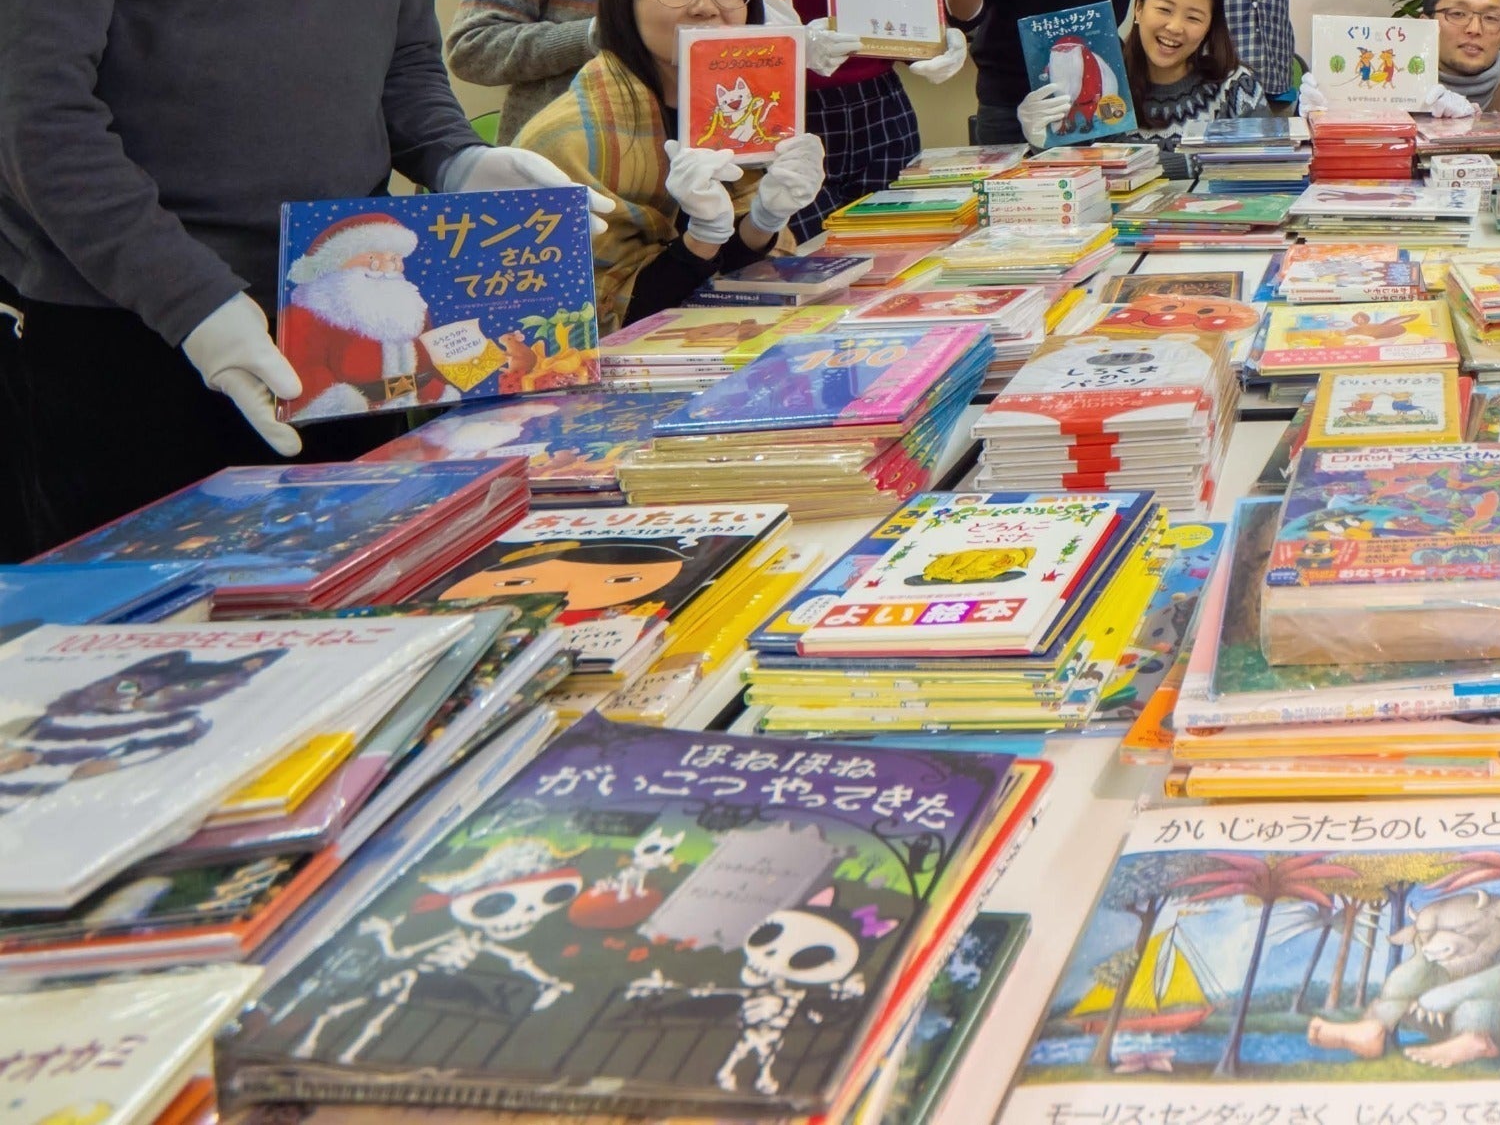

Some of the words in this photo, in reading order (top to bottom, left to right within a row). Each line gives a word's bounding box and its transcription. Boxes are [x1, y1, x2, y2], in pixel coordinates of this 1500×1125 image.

[428, 208, 563, 258] サンタ
[500, 246, 562, 267] さんの
[454, 269, 548, 299] てがみ
[1067, 365, 1160, 376] しろくま
[1061, 378, 1147, 389] パンツ
[523, 511, 766, 530] おしりたんてい
[966, 521, 1051, 533] どろんこ
[966, 534, 1036, 544] こぶた
[823, 599, 1021, 625] よい絵本
[48, 627, 396, 654] 100万回生きたねこ
[680, 743, 878, 779] ほねほね
[535, 765, 748, 797] がいこつ
[760, 775, 956, 830] やってきた
